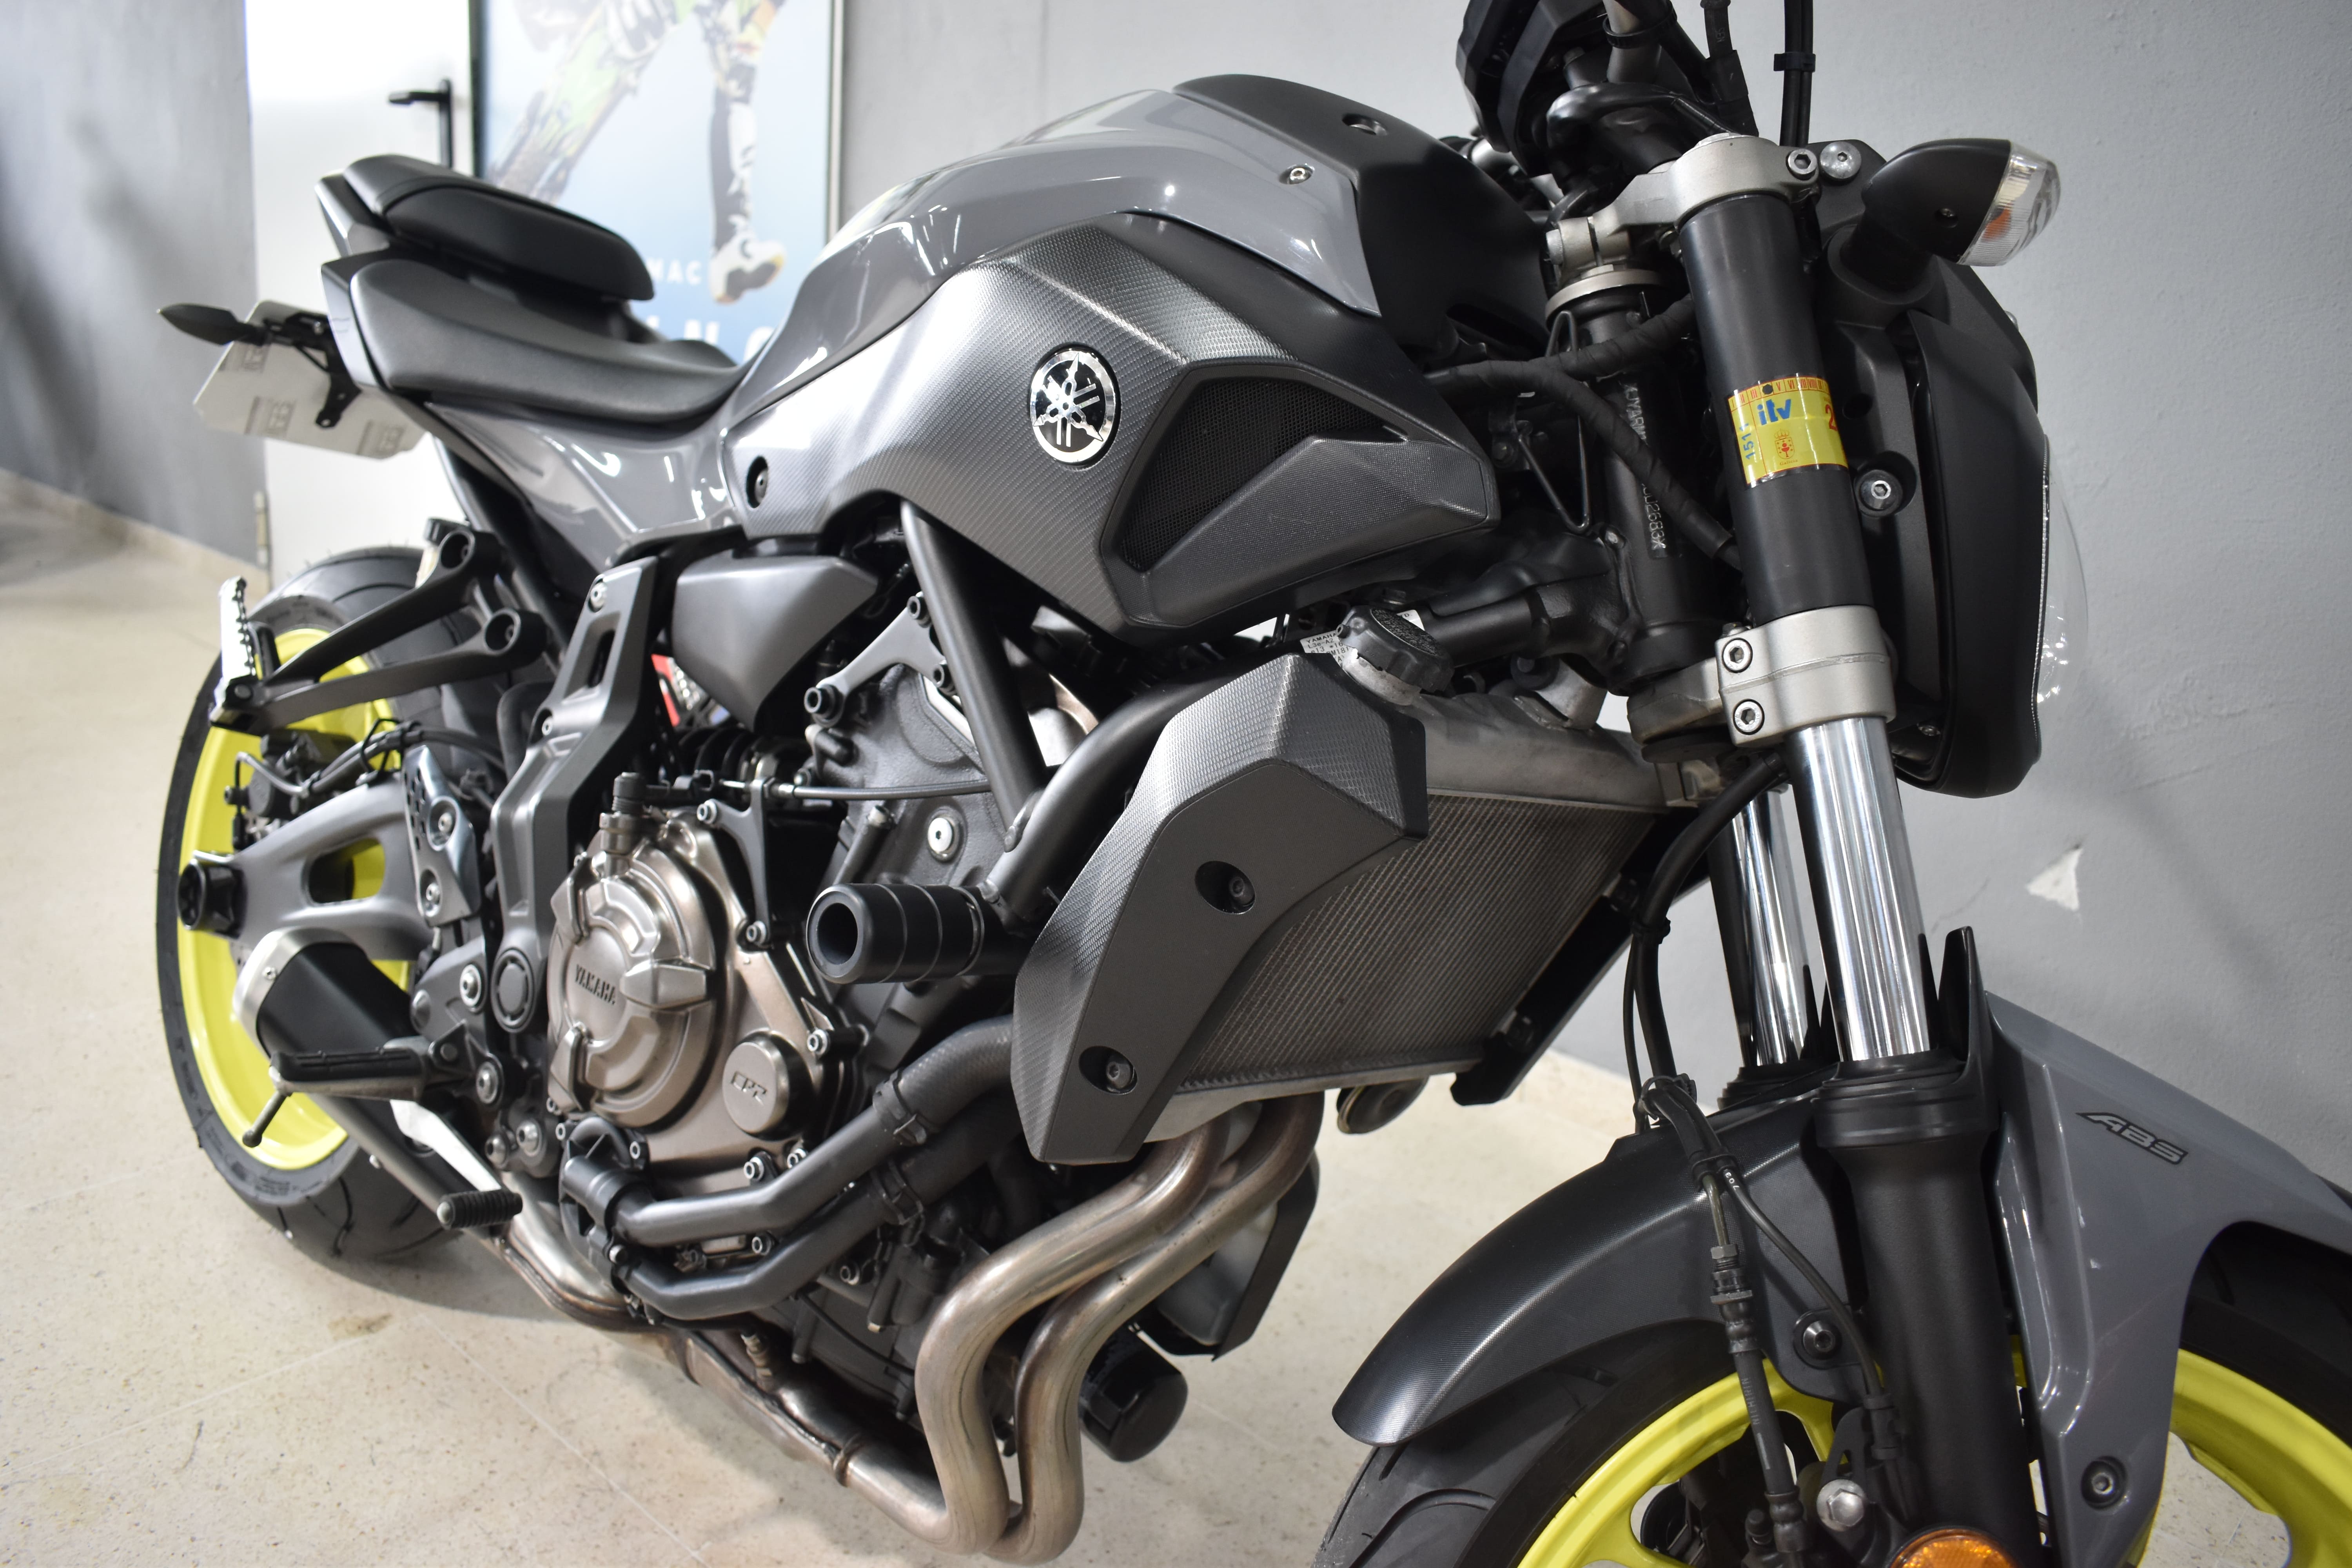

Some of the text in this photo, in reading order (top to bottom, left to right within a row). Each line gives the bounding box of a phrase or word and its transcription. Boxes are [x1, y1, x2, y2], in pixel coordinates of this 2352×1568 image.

[1776, 382, 1781, 391] V
[1788, 379, 1795, 389] VI
[1757, 399, 1791, 426] itv
[1306, 633, 1337, 643] YAMAHA
[575, 964, 616, 1005] YAMAHA
[2075, 1112, 2189, 1165] ABS
